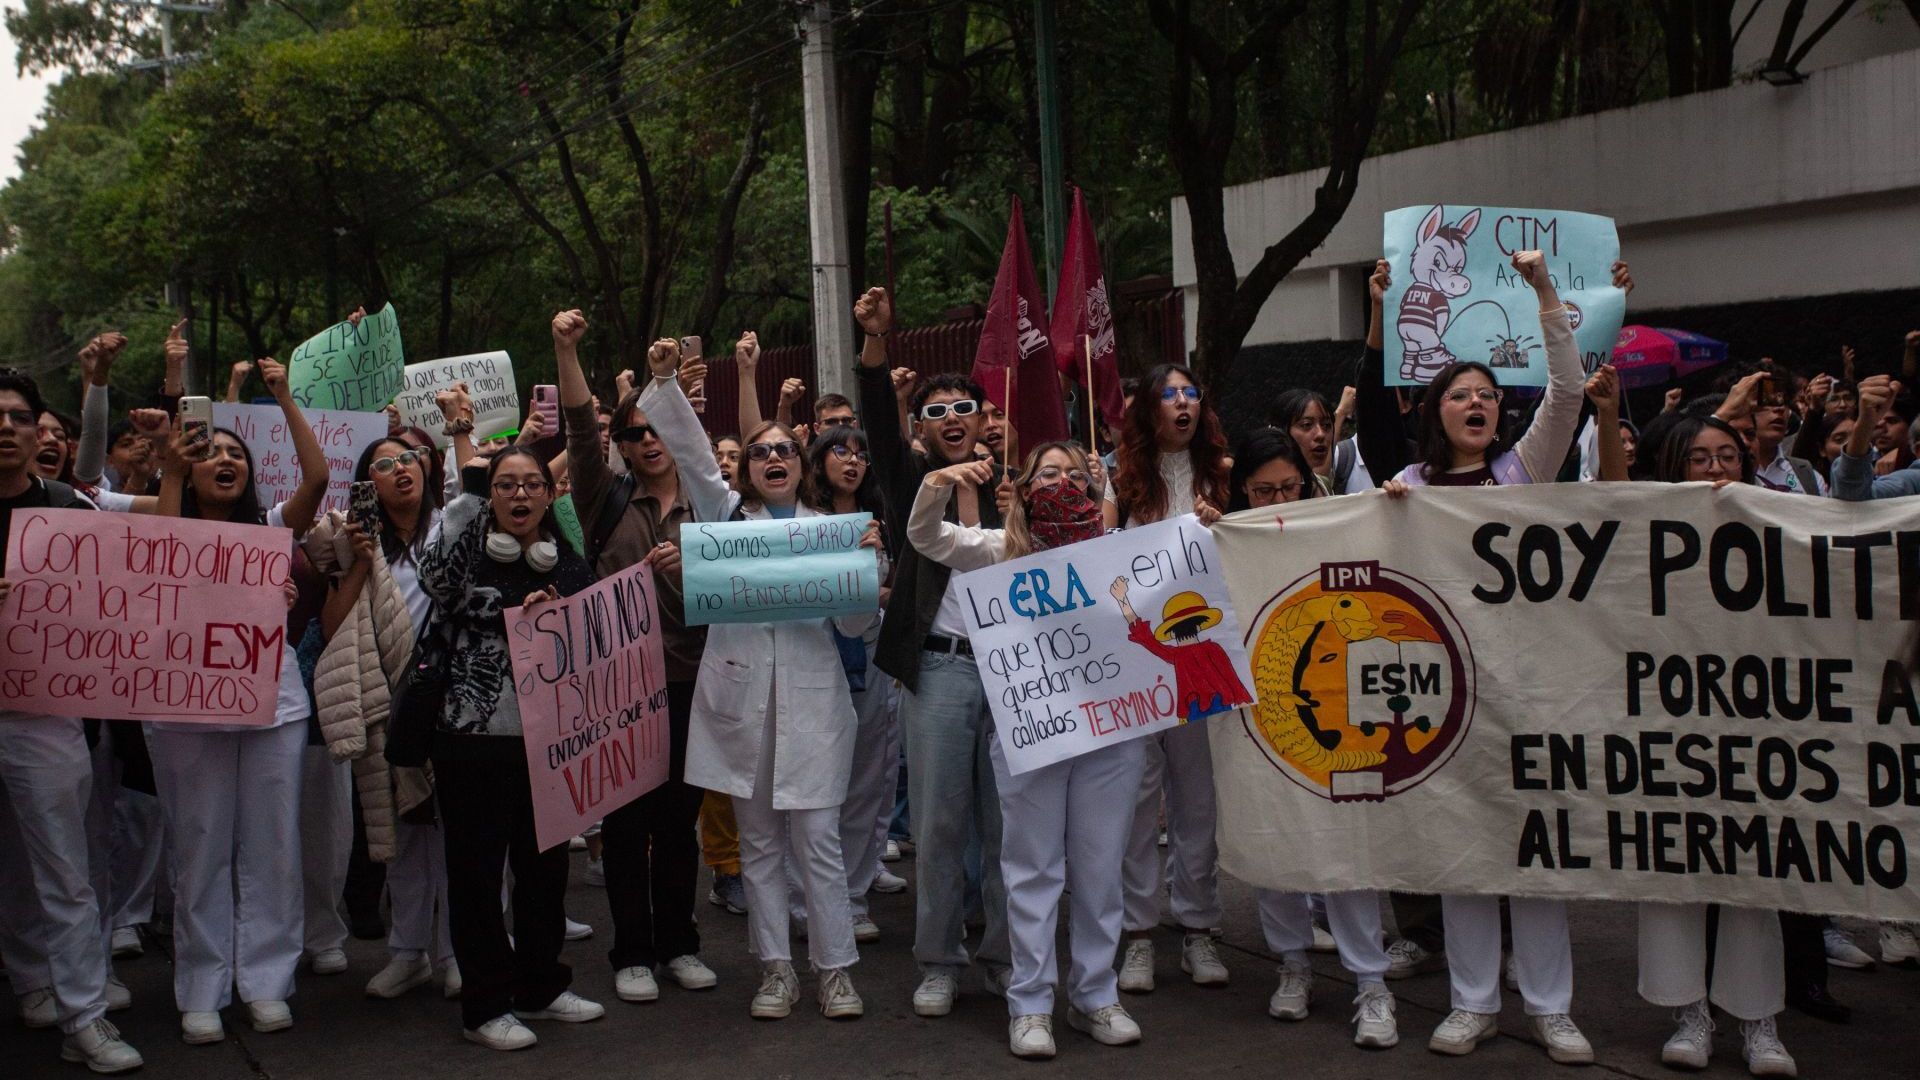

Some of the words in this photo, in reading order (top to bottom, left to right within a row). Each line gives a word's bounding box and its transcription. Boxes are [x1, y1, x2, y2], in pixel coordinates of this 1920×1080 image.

[1495, 215, 1557, 257] CTM
[1406, 290, 1431, 305] IPN
[1569, 261, 1585, 291] la
[322, 317, 370, 354] IPN
[312, 356, 338, 382] SE
[347, 340, 392, 376] VENDE
[415, 369, 440, 389] QUE
[443, 366, 458, 382] SE
[460, 359, 496, 378] AMA
[328, 357, 404, 412] DEFIENDE
[474, 377, 505, 394] CUIDA
[311, 414, 354, 447] strés
[255, 468, 288, 487] duele
[262, 450, 280, 468] de
[20, 514, 99, 575] Con
[120, 526, 190, 579] tanto
[195, 534, 291, 586] dinero
[699, 524, 771, 562] Somos
[784, 518, 864, 554] BURROS
[1471, 519, 1622, 604] SOY
[967, 587, 1007, 630] La
[1008, 562, 1097, 622] ERA
[1131, 549, 1177, 588] en
[1179, 526, 1209, 577] la
[1328, 566, 1371, 589] IPN
[98, 581, 128, 621] la
[138, 582, 187, 625] 4T
[695, 592, 723, 611] no
[534, 604, 576, 684] SI
[581, 590, 613, 666] NO
[613, 571, 651, 648] NOS
[166, 629, 192, 664] la
[202, 622, 284, 682] ESM
[988, 642, 1036, 683] que
[1034, 623, 1091, 664] nos
[48, 673, 97, 700] cae
[1002, 653, 1121, 724] quedamos
[1361, 663, 1441, 696] ESM
[1626, 652, 1854, 723] PORQUE
[548, 716, 611, 770] ENTONCES
[617, 701, 645, 729] QUE
[647, 687, 669, 714] NOS
[1012, 703, 1077, 749] callados
[1078, 675, 1175, 737] TERMINÓ
[1511, 733, 1588, 791] EN
[1603, 731, 1840, 804] DESEOS
[1516, 808, 1592, 869] AL
[1607, 810, 1908, 890] HERMANO
